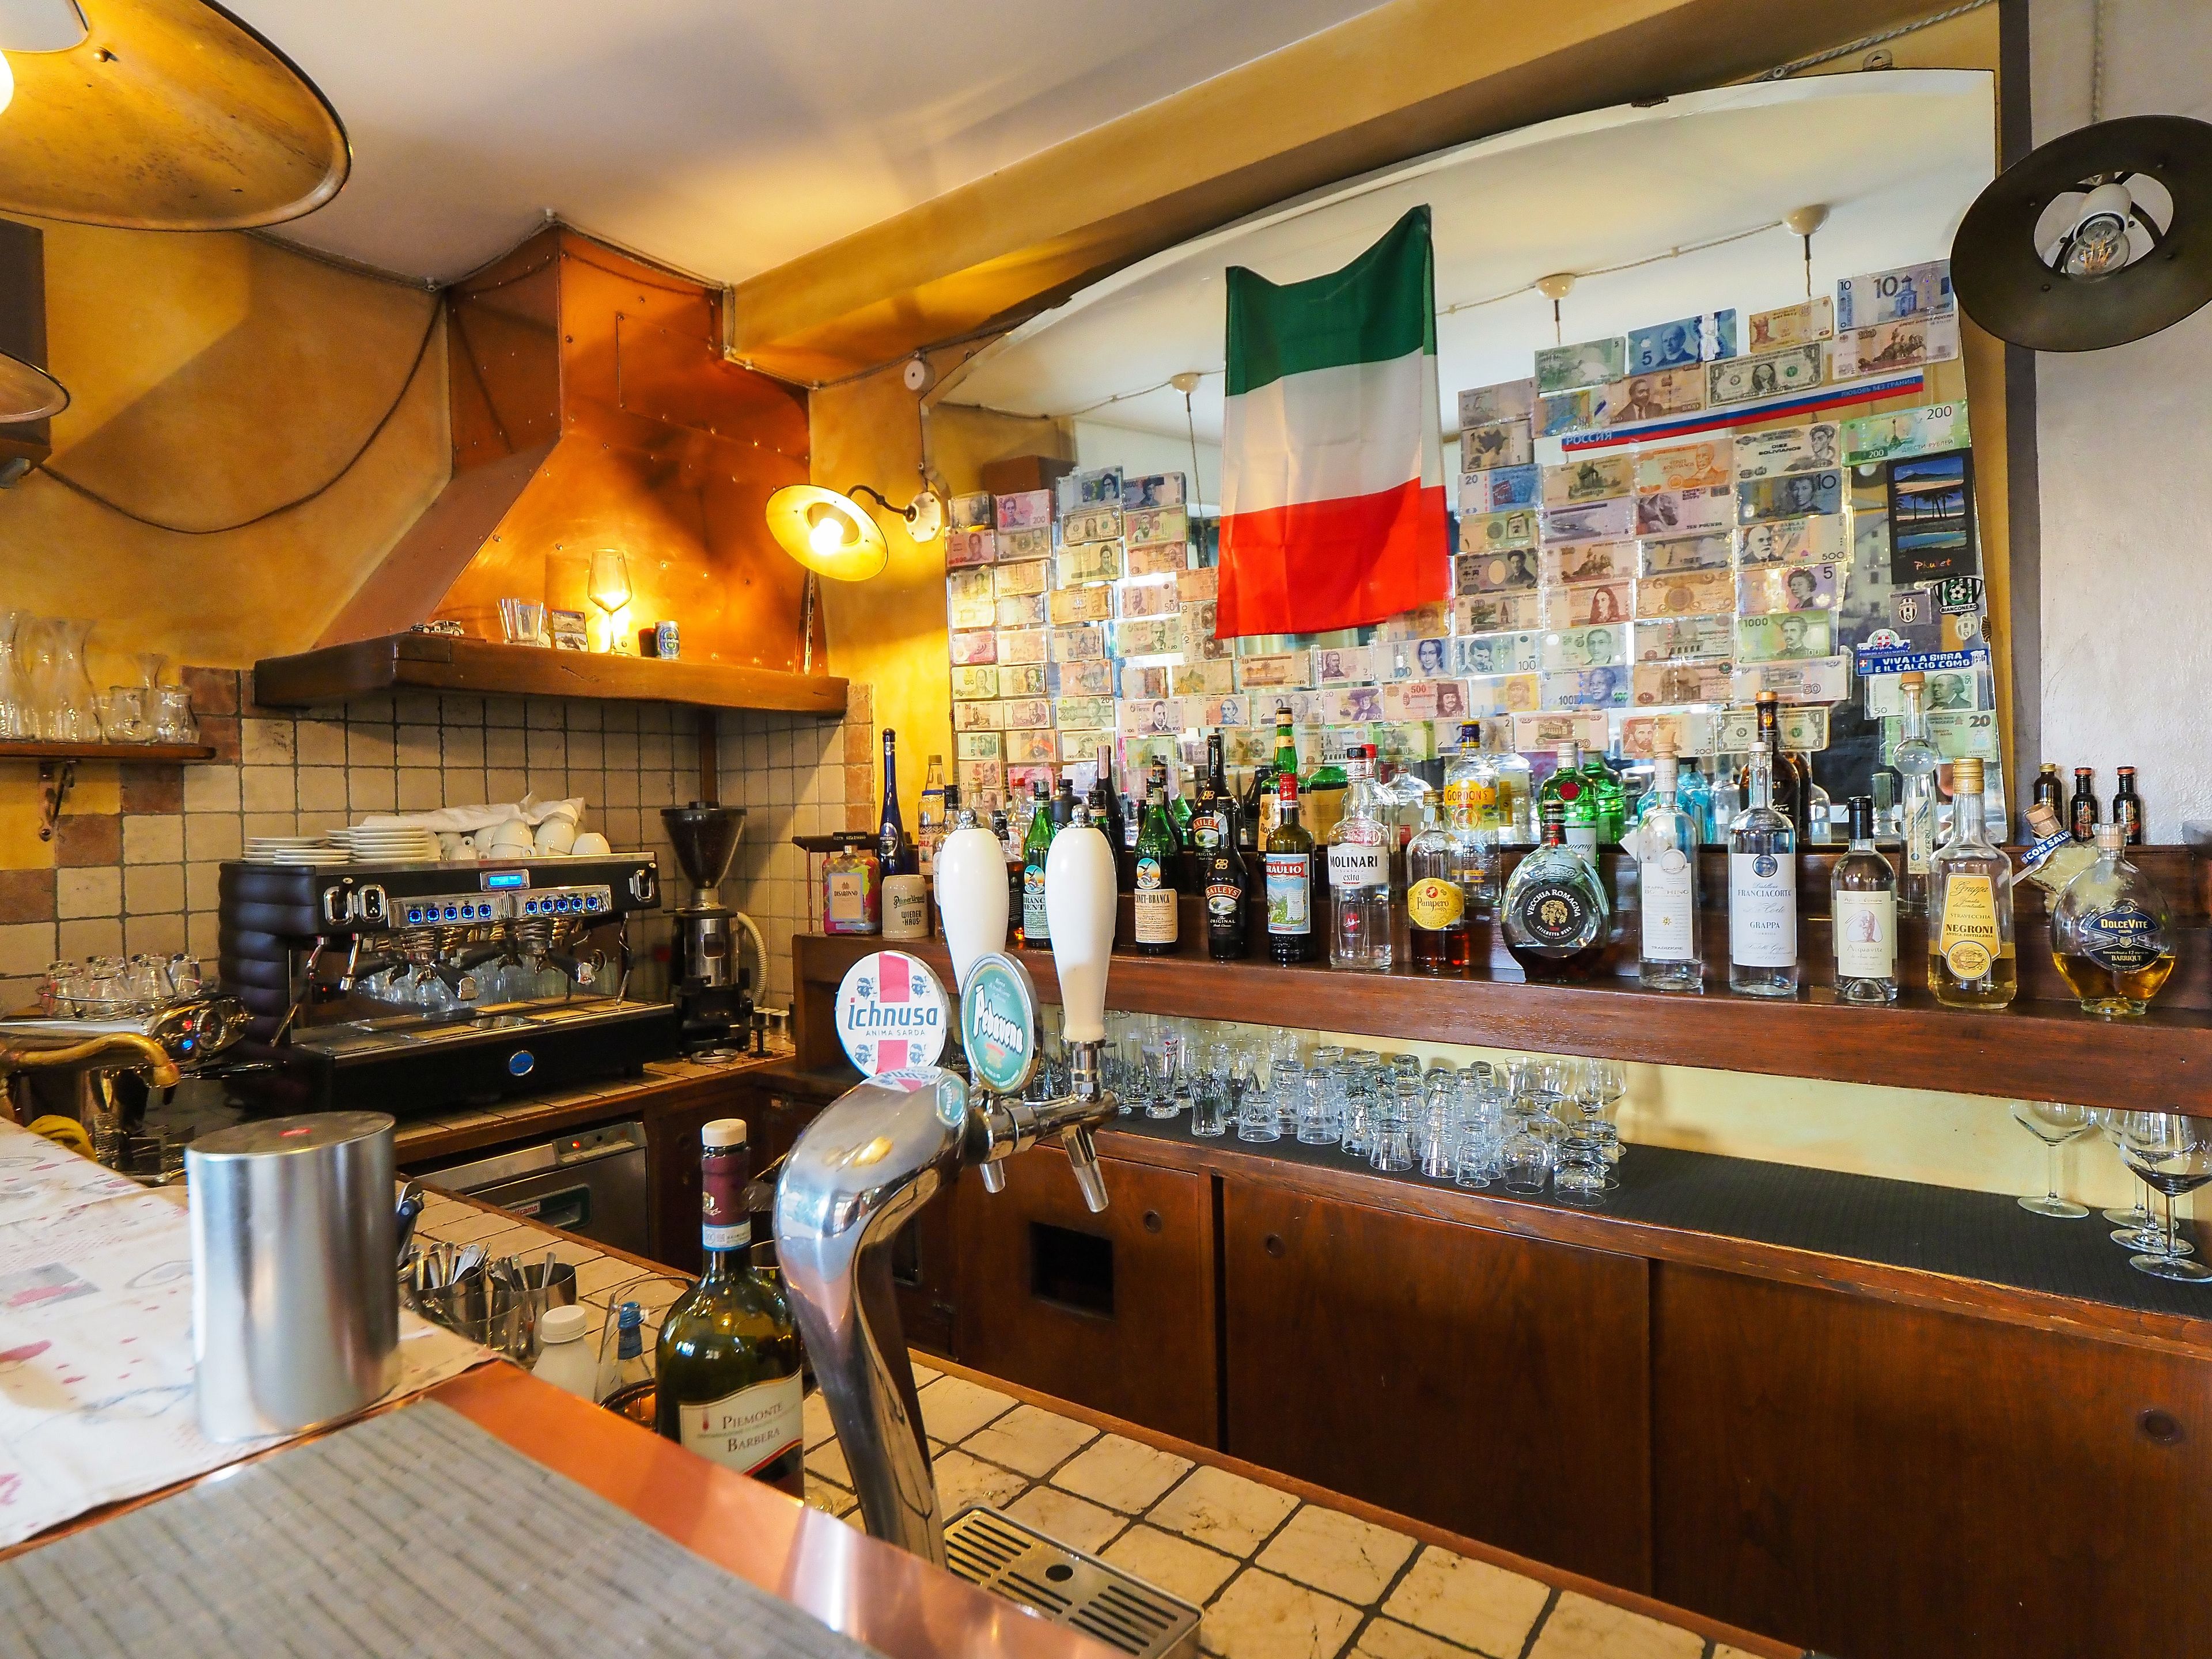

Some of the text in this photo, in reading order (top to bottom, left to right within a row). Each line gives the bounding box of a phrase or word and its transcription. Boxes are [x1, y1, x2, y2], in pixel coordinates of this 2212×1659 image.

[1840, 281, 1851, 290] 10
[1873, 276, 1898, 298] 10
[1642, 350, 1653, 366] 5
[1927, 406, 1952, 420] 200
[1566, 430, 1613, 445] РОССИЯ
[1928, 439, 1953, 448] РУБЛЕЙ
[1868, 449, 1884, 458] 200
[1465, 474, 1479, 485] 20
[1821, 551, 1844, 560] 500
[1914, 558, 1952, 570] Phuet
[1823, 566, 1833, 579] 5
[1164, 602, 1175, 612] 50
[1941, 604, 1978, 613] BIANCONERO
[1744, 618, 1768, 627] 1000
[1882, 652, 1963, 665] VIVA LA BIRRA
[1518, 661, 1536, 671] 100
[1884, 664, 1894, 672] IL
[1896, 661, 1936, 672] CALCIO
[1938, 659, 1970, 669] COMO
[1393, 666, 1412, 678] 100
[1411, 685, 1426, 693] 500
[1803, 684, 1821, 694] 50
[1558, 695, 1573, 705] 100
[1969, 714, 1991, 728] 20
[1573, 738, 1590, 748] 00
[1193, 818, 1218, 830] BAILEY
[2027, 844, 2047, 861] CON
[1330, 855, 1378, 868] MOLINARI
[1343, 873, 1359, 881] extra
[1206, 885, 1238, 897] BAILEYS
[1737, 889, 1791, 897] FRANCIACORTA
[1950, 880, 1988, 896] Grappa
[1135, 893, 1170, 904] NET-BRANCA
[1417, 897, 1449, 912] Pampero
[1527, 889, 1581, 917] VECCHIA ROMAGNA
[901, 910, 922, 918] WIENER
[1946, 924, 1993, 934] NEGRONI
[848, 997, 938, 1031] ichnusa
[972, 984, 1024, 1055] Pedavena
[722, 1402, 782, 1430] PIEMONTE
[728, 1427, 780, 1452] BARBERA
